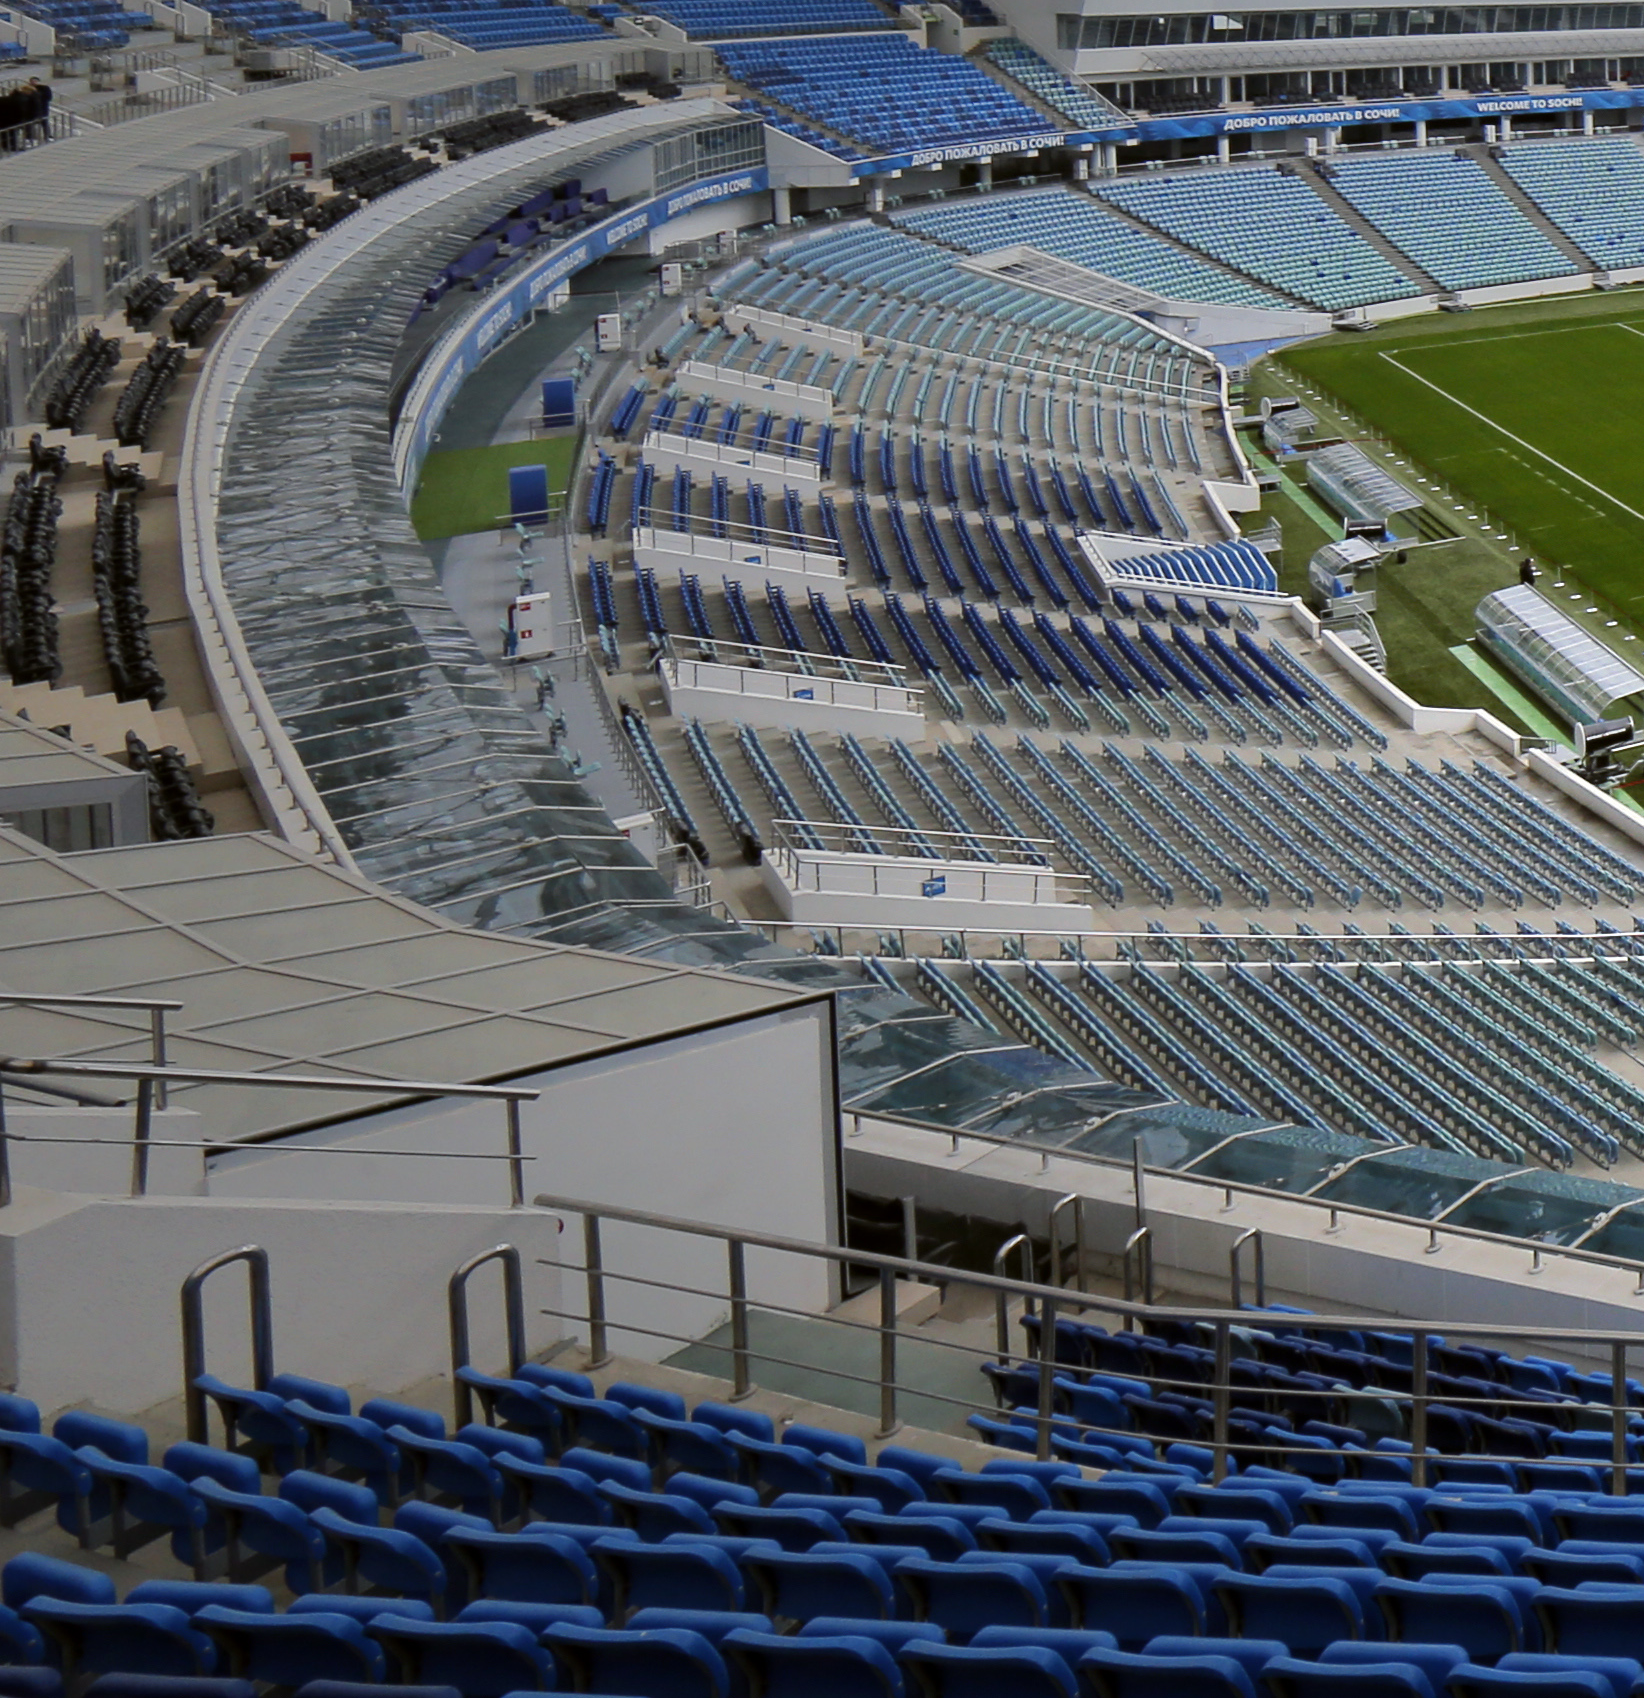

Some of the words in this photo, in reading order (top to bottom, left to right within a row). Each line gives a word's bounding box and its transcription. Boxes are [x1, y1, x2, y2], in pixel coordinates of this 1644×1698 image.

[1477, 101, 1530, 111] WELCOME
[1532, 100, 1547, 109] TO
[1548, 97, 1583, 107] SOCHI!
[1224, 117, 1267, 130] ДОБРО
[1269, 112, 1353, 125] ПОЖАЛОВАТЬ
[1355, 111, 1362, 119] В
[1364, 109, 1400, 119] СОЧИ!
[911, 152, 944, 167] ДОБРО
[945, 141, 1019, 160] ПОЖАЛОВАТЬ
[1021, 140, 1028, 150] В
[1029, 135, 1065, 149] СОЧИ!
